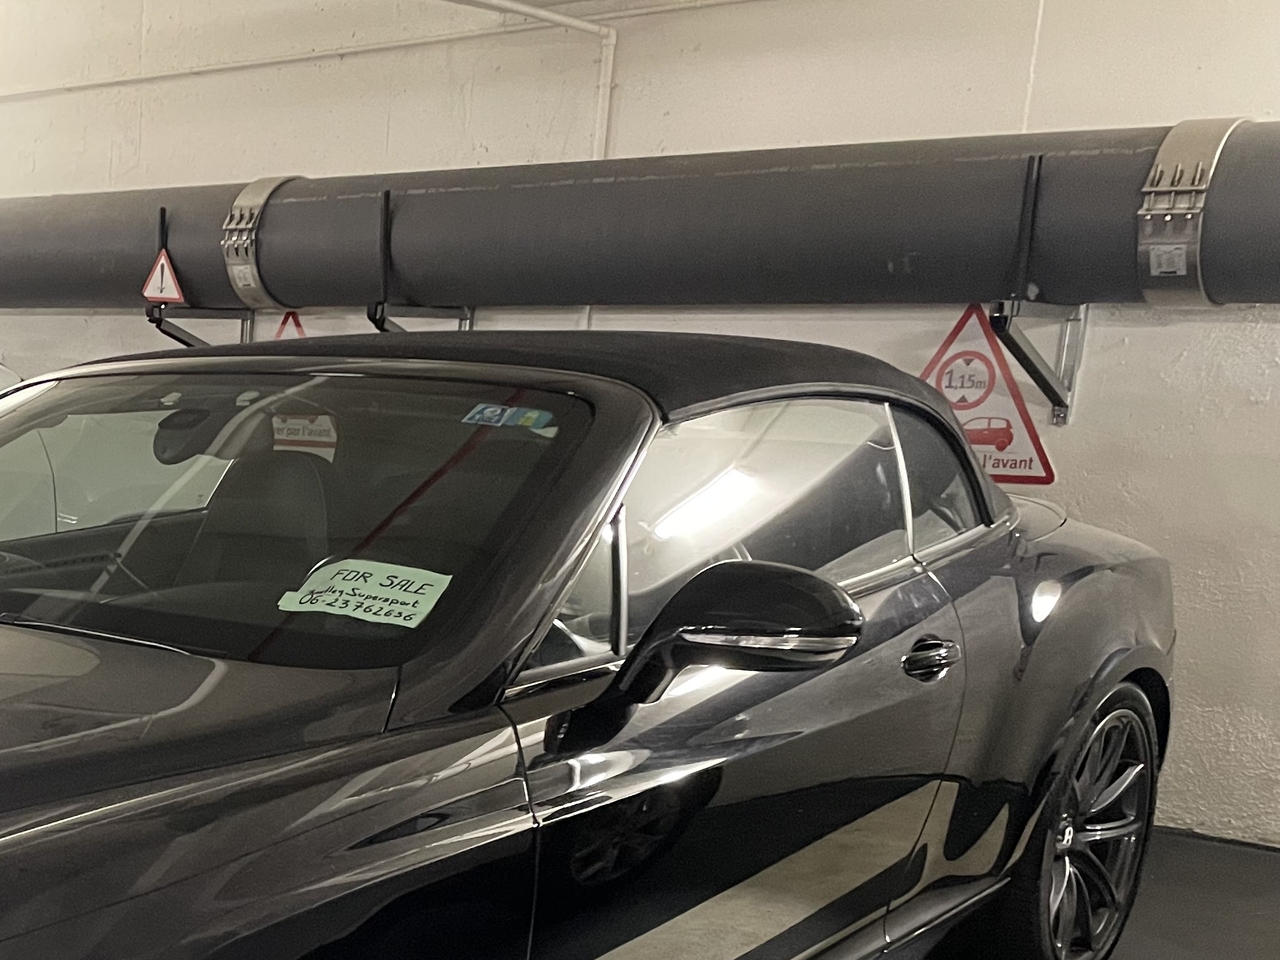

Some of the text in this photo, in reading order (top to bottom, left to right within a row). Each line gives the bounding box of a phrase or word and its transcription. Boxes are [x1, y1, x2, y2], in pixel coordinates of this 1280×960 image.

[983, 454, 1033, 470] l'avant
[330, 569, 434, 595] FOR SALE
